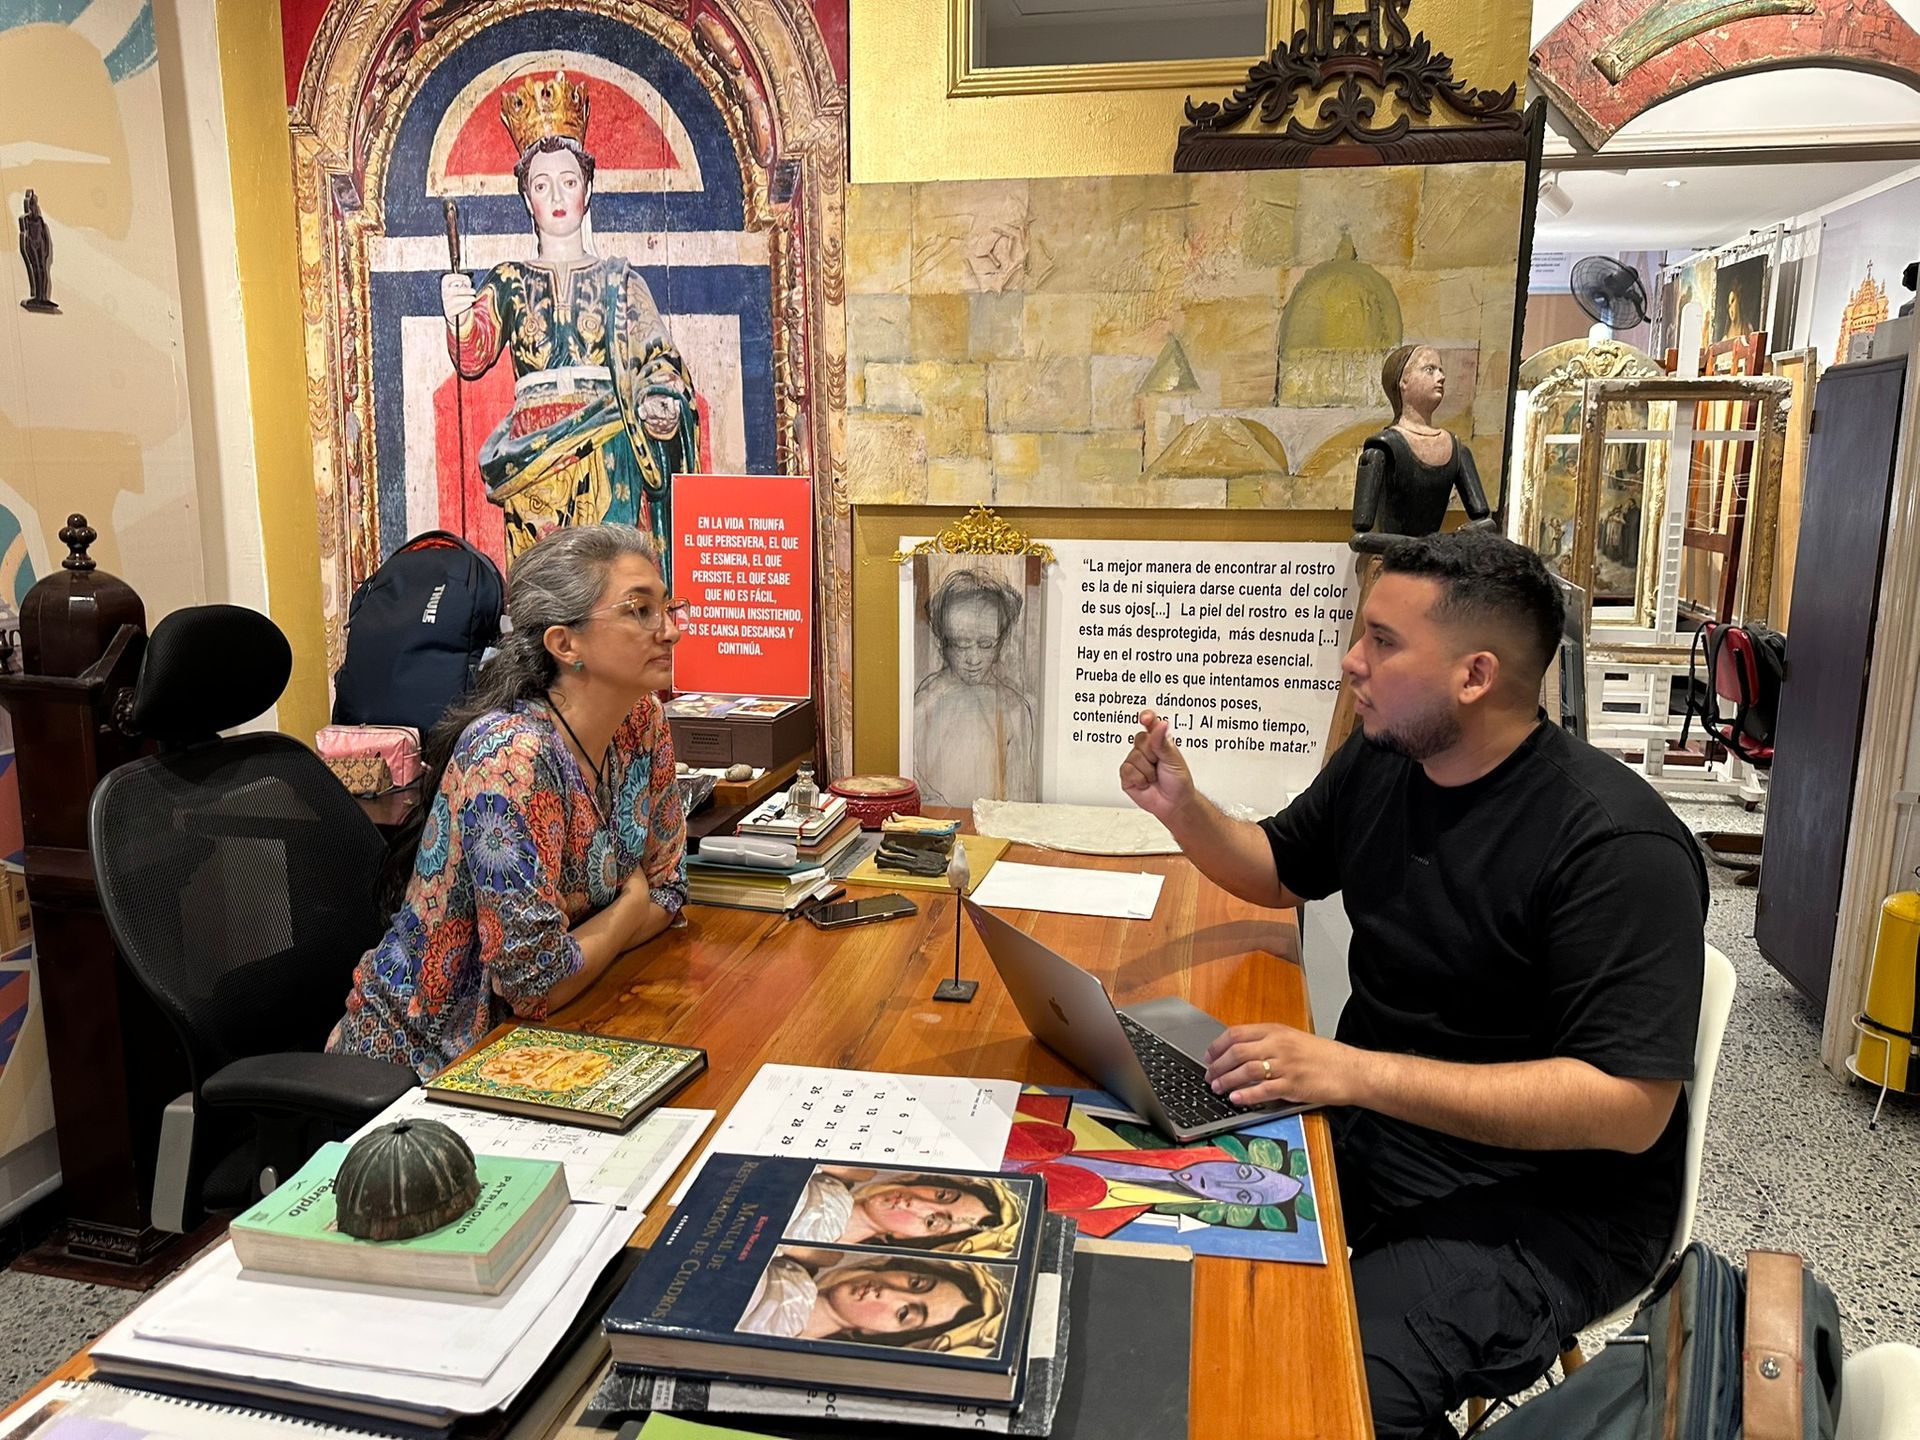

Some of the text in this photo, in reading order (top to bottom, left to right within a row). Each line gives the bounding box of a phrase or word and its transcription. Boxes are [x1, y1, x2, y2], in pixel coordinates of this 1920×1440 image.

[698, 517, 784, 530] EN LA VIDA TRIUNFA
[685, 534, 798, 549] EL QUE PERSEVERA, EL QUE
[701, 552, 782, 567] SE ESMERA, EL QUE
[1108, 559, 1142, 576] mejor
[1146, 563, 1191, 573] manera
[1196, 560, 1210, 573] de
[1215, 561, 1277, 574] encontrar
[1280, 561, 1291, 574] al
[1296, 562, 1335, 575] rostro
[693, 570, 790, 585] PERSISTE, EL QUE SABE
[705, 588, 776, 603] QUE NO ES FÁCIL,
[1082, 579, 1348, 598] es la de ni siquiera darse cuenta del color
[422, 584, 446, 624] THULE
[690, 606, 803, 622] RO CONTINUA INSISTIENDO,
[1082, 601, 1096, 613] de
[1100, 604, 1121, 614] sus
[1181, 603, 1195, 616] La
[1200, 603, 1222, 619] piel
[1226, 604, 1244, 617] del
[1249, 606, 1287, 618] rostro
[1295, 608, 1309, 618] es
[1314, 605, 1324, 618] la
[1329, 609, 1353, 622] que
[699, 624, 709, 636] SE
[711, 624, 739, 637] CANSA
[742, 625, 785, 638] DESCANSA
[788, 627, 793, 638] Y
[1079, 624, 1103, 636] esta
[1108, 624, 1132, 637] más
[1136, 625, 1220, 642] desprotegida,
[1229, 627, 1255, 640] más
[1259, 628, 1314, 642] desnuda
[718, 639, 763, 656] CONTINÚA.
[1078, 646, 1312, 667] Hay en el rostro una pobreza esencial.
[1076, 668, 1341, 692] Prueba de ello es que intentamos enmasca
[1075, 691, 1261, 712] esa pobreza dándonos poses,
[1200, 715, 1213, 728] Al
[1217, 716, 1258, 730] mismo
[1263, 719, 1309, 735] tiempo,
[1073, 730, 1082, 741] el
[1087, 731, 1122, 744] rostro
[1186, 738, 1208, 748] nos
[1215, 737, 1264, 752] prohíbe
[781, 1085, 823, 1145] 26 27 28 29
[815, 1089, 854, 1149] 19 20 21 22
[850, 1091, 886, 1151] 12 13 14 15
[456, 1175, 512, 1235] PATRIMONIO
[651, 1259, 700, 1319] CUADROS
